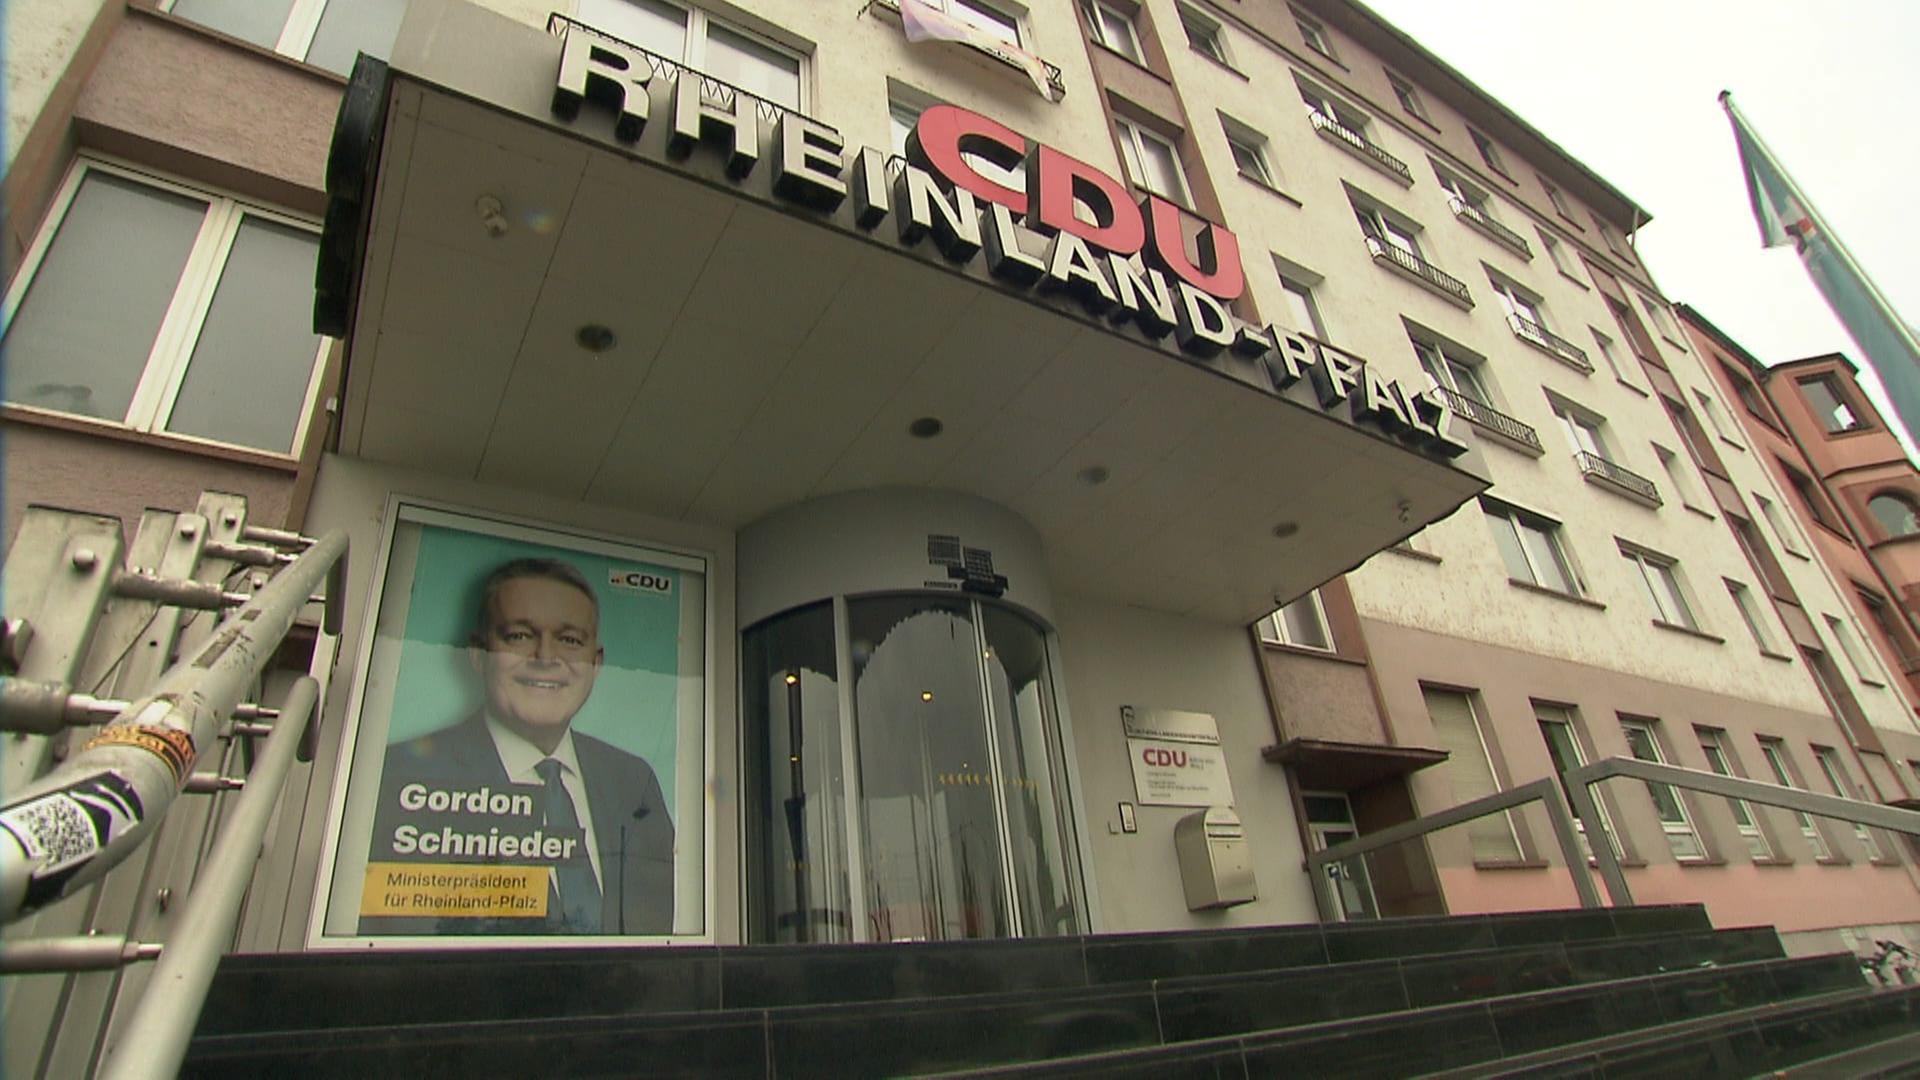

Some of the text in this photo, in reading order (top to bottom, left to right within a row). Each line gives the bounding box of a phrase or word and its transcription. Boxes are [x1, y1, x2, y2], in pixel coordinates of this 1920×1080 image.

[912, 104, 1245, 300] CDU
[555, 28, 1468, 454] RHEINLAND-PFALZ
[625, 573, 669, 591] CDU
[1142, 748, 1187, 768] CDU
[399, 783, 533, 816] Gordon
[392, 824, 577, 860] Schnieder
[386, 872, 527, 890] Ministerpräsident
[384, 893, 539, 910] für Rheinland-Pfalz
